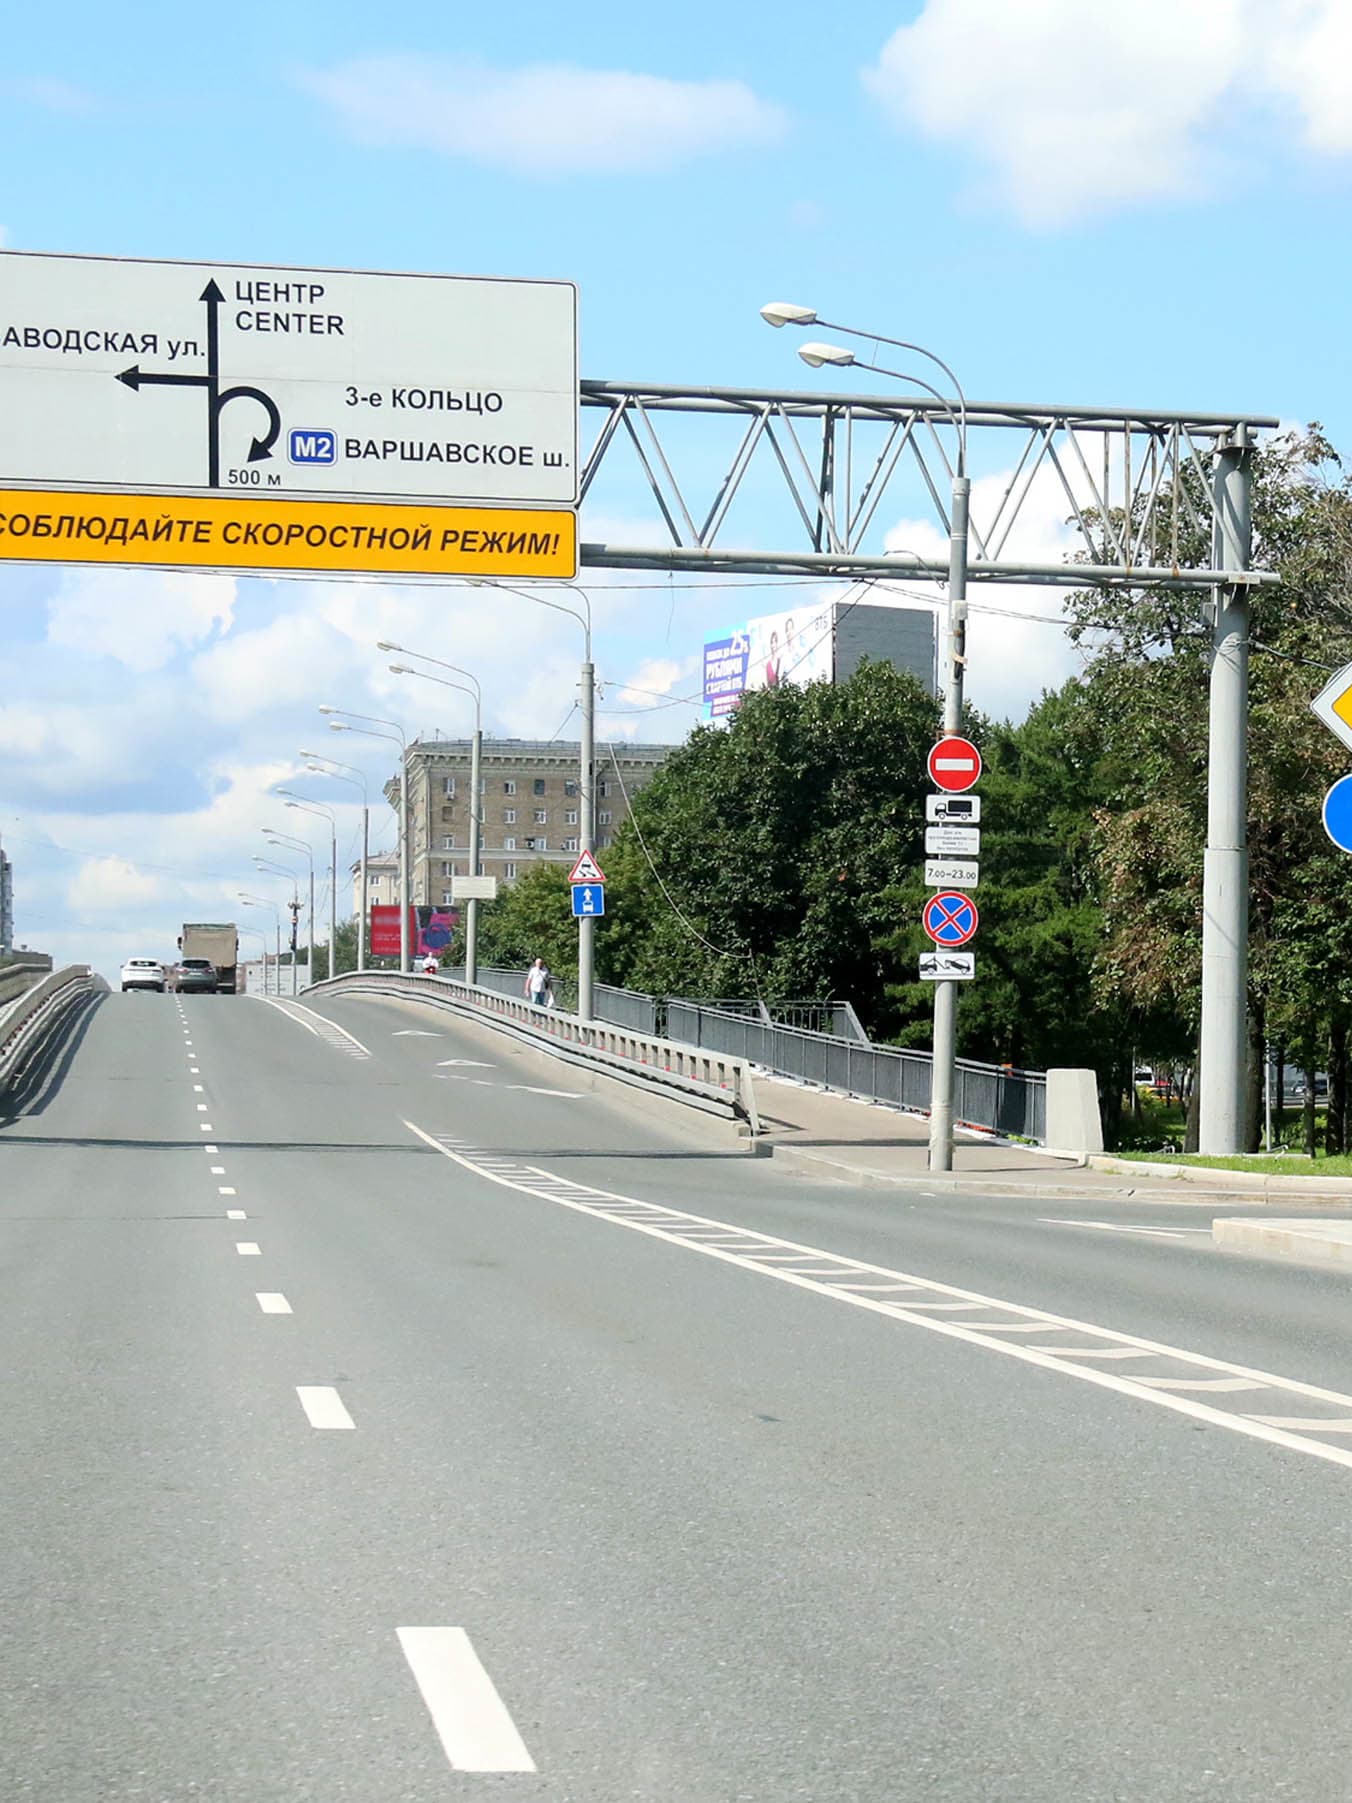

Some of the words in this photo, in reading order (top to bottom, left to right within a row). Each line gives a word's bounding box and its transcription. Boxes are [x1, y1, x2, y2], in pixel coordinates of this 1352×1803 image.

[235, 280, 325, 305] ЦЕНТР
[235, 310, 345, 336] CENTER
[2, 326, 158, 355] АВОДСКАЯ
[167, 338, 206, 360] ул.
[345, 386, 383, 408] 3-е
[392, 388, 503, 415] КОЛЬЦО
[295, 436, 331, 458] М2
[345, 438, 534, 467] ВАРШАВСКОЕ
[543, 452, 570, 468] ш.
[228, 468, 261, 486] 500
[267, 474, 281, 486] м
[222, 521, 432, 551] СКОРОСТНОЙ
[440, 529, 560, 556] РЕЖИМ!
